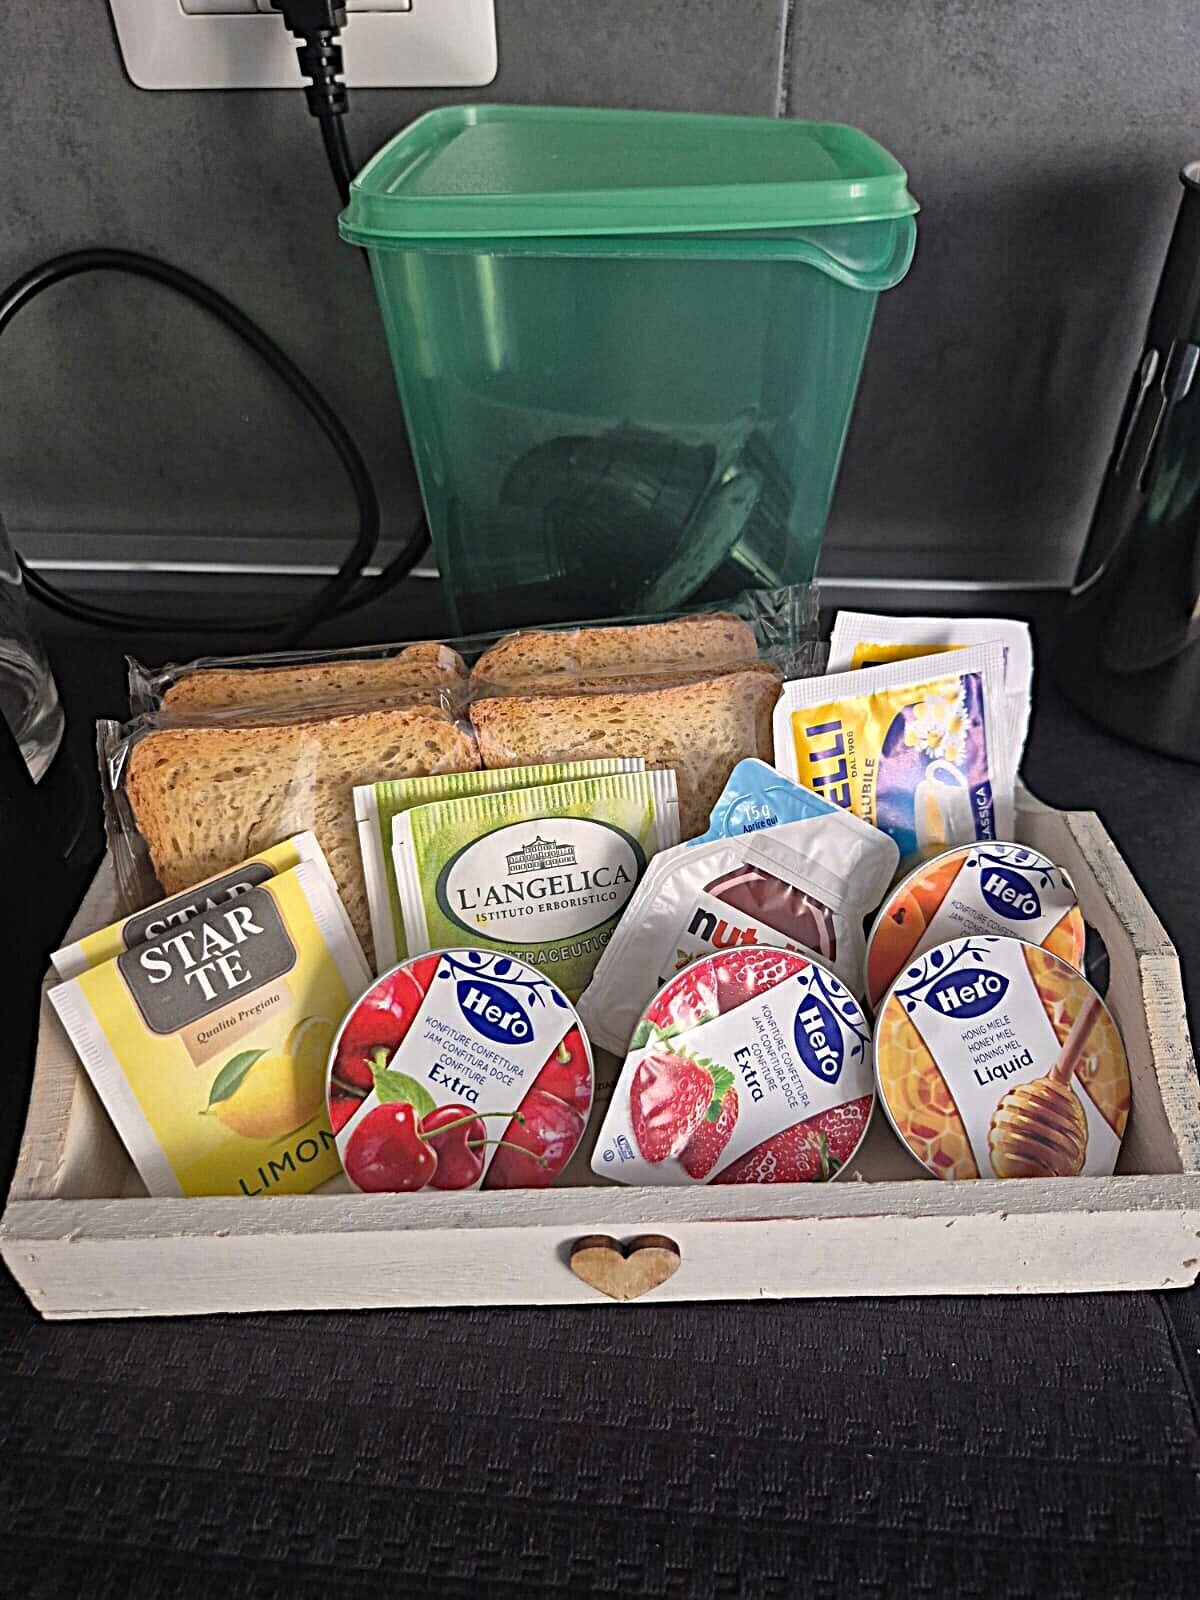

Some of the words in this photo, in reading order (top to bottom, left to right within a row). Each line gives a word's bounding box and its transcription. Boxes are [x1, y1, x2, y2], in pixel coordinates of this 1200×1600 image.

[848, 757, 857, 777] DAL
[458, 864, 631, 910] L'ANGELICA
[476, 905, 534, 922] ISTITUTO
[538, 891, 617, 913] ERBORISTICO
[983, 873, 1037, 914] Hero
[140, 906, 265, 984] STAR
[688, 907, 768, 949] nut
[237, 994, 280, 1022] Pregiata
[462, 987, 528, 1038] Hero
[936, 974, 1001, 1013] Hero
[425, 1016, 471, 1047] KONFITURE
[471, 1042, 524, 1078] CONFETTURA
[798, 1006, 839, 1076] Hero
[961, 1025, 987, 1041] HONIG
[987, 1015, 1011, 1030] MIELE
[968, 1035, 995, 1053] HONEY
[996, 1028, 1016, 1041] MIEL
[424, 1031, 442, 1044] JAM
[442, 1040, 489, 1072] CONFITURA
[490, 1068, 515, 1086] DOCE
[440, 1053, 486, 1085] CONFITURE
[751, 1043, 777, 1092] CONFITURE
[752, 1016, 765, 1033] JAM
[761, 1034, 786, 1082] CONFITURA
[782, 1083, 799, 1109] DOCE
[761, 1004, 787, 1051] KONFITURE
[781, 1051, 810, 1108] CONFETTURA
[973, 1046, 1005, 1064] HONING
[1004, 1040, 1022, 1052] MEL
[974, 1049, 1034, 1086] Liquid
[428, 1062, 479, 1104] Extra
[734, 1046, 764, 1103] Extra
